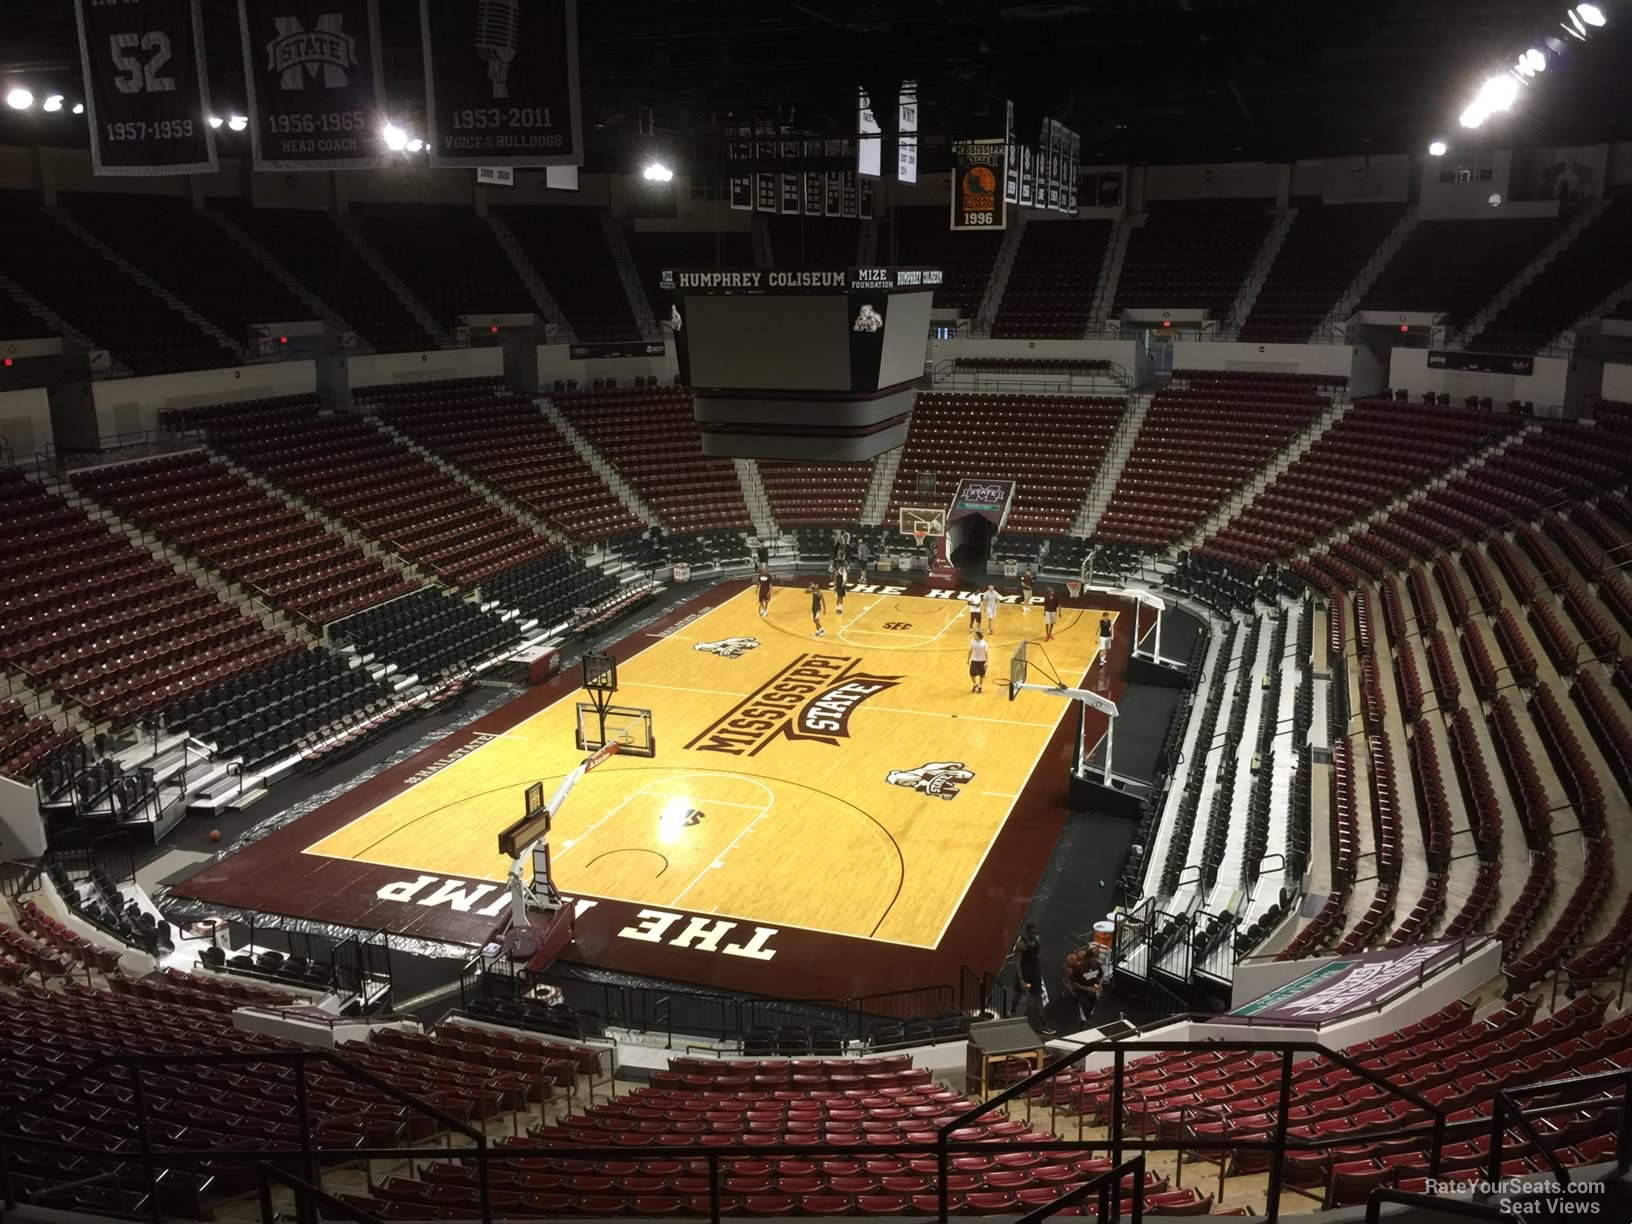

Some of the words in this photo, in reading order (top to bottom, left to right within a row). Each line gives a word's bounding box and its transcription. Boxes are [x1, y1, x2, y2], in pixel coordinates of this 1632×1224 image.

[282, 37, 341, 62] STATE
[110, 30, 177, 94] 52
[269, 111, 364, 134] 1956-1965
[452, 107, 552, 129] 1953-2011
[106, 119, 193, 141] 1957-1959
[282, 140, 315, 152] HEAD
[318, 138, 357, 151] COACH
[444, 136, 482, 149] VOICE
[496, 134, 563, 148] BULLDOGS
[964, 212, 993, 225] 1996
[679, 273, 762, 287] HUMPHREY
[768, 272, 846, 287] COLISEUM
[851, 280, 893, 289] FOUNDATION
[858, 269, 887, 281] MIZE
[882, 621, 913, 631] SEC
[695, 653, 853, 756] MISSISSIPPI
[805, 682, 884, 732] STATE
[403, 734, 495, 785] #HAILSTATE
[616, 908, 779, 961] THE
